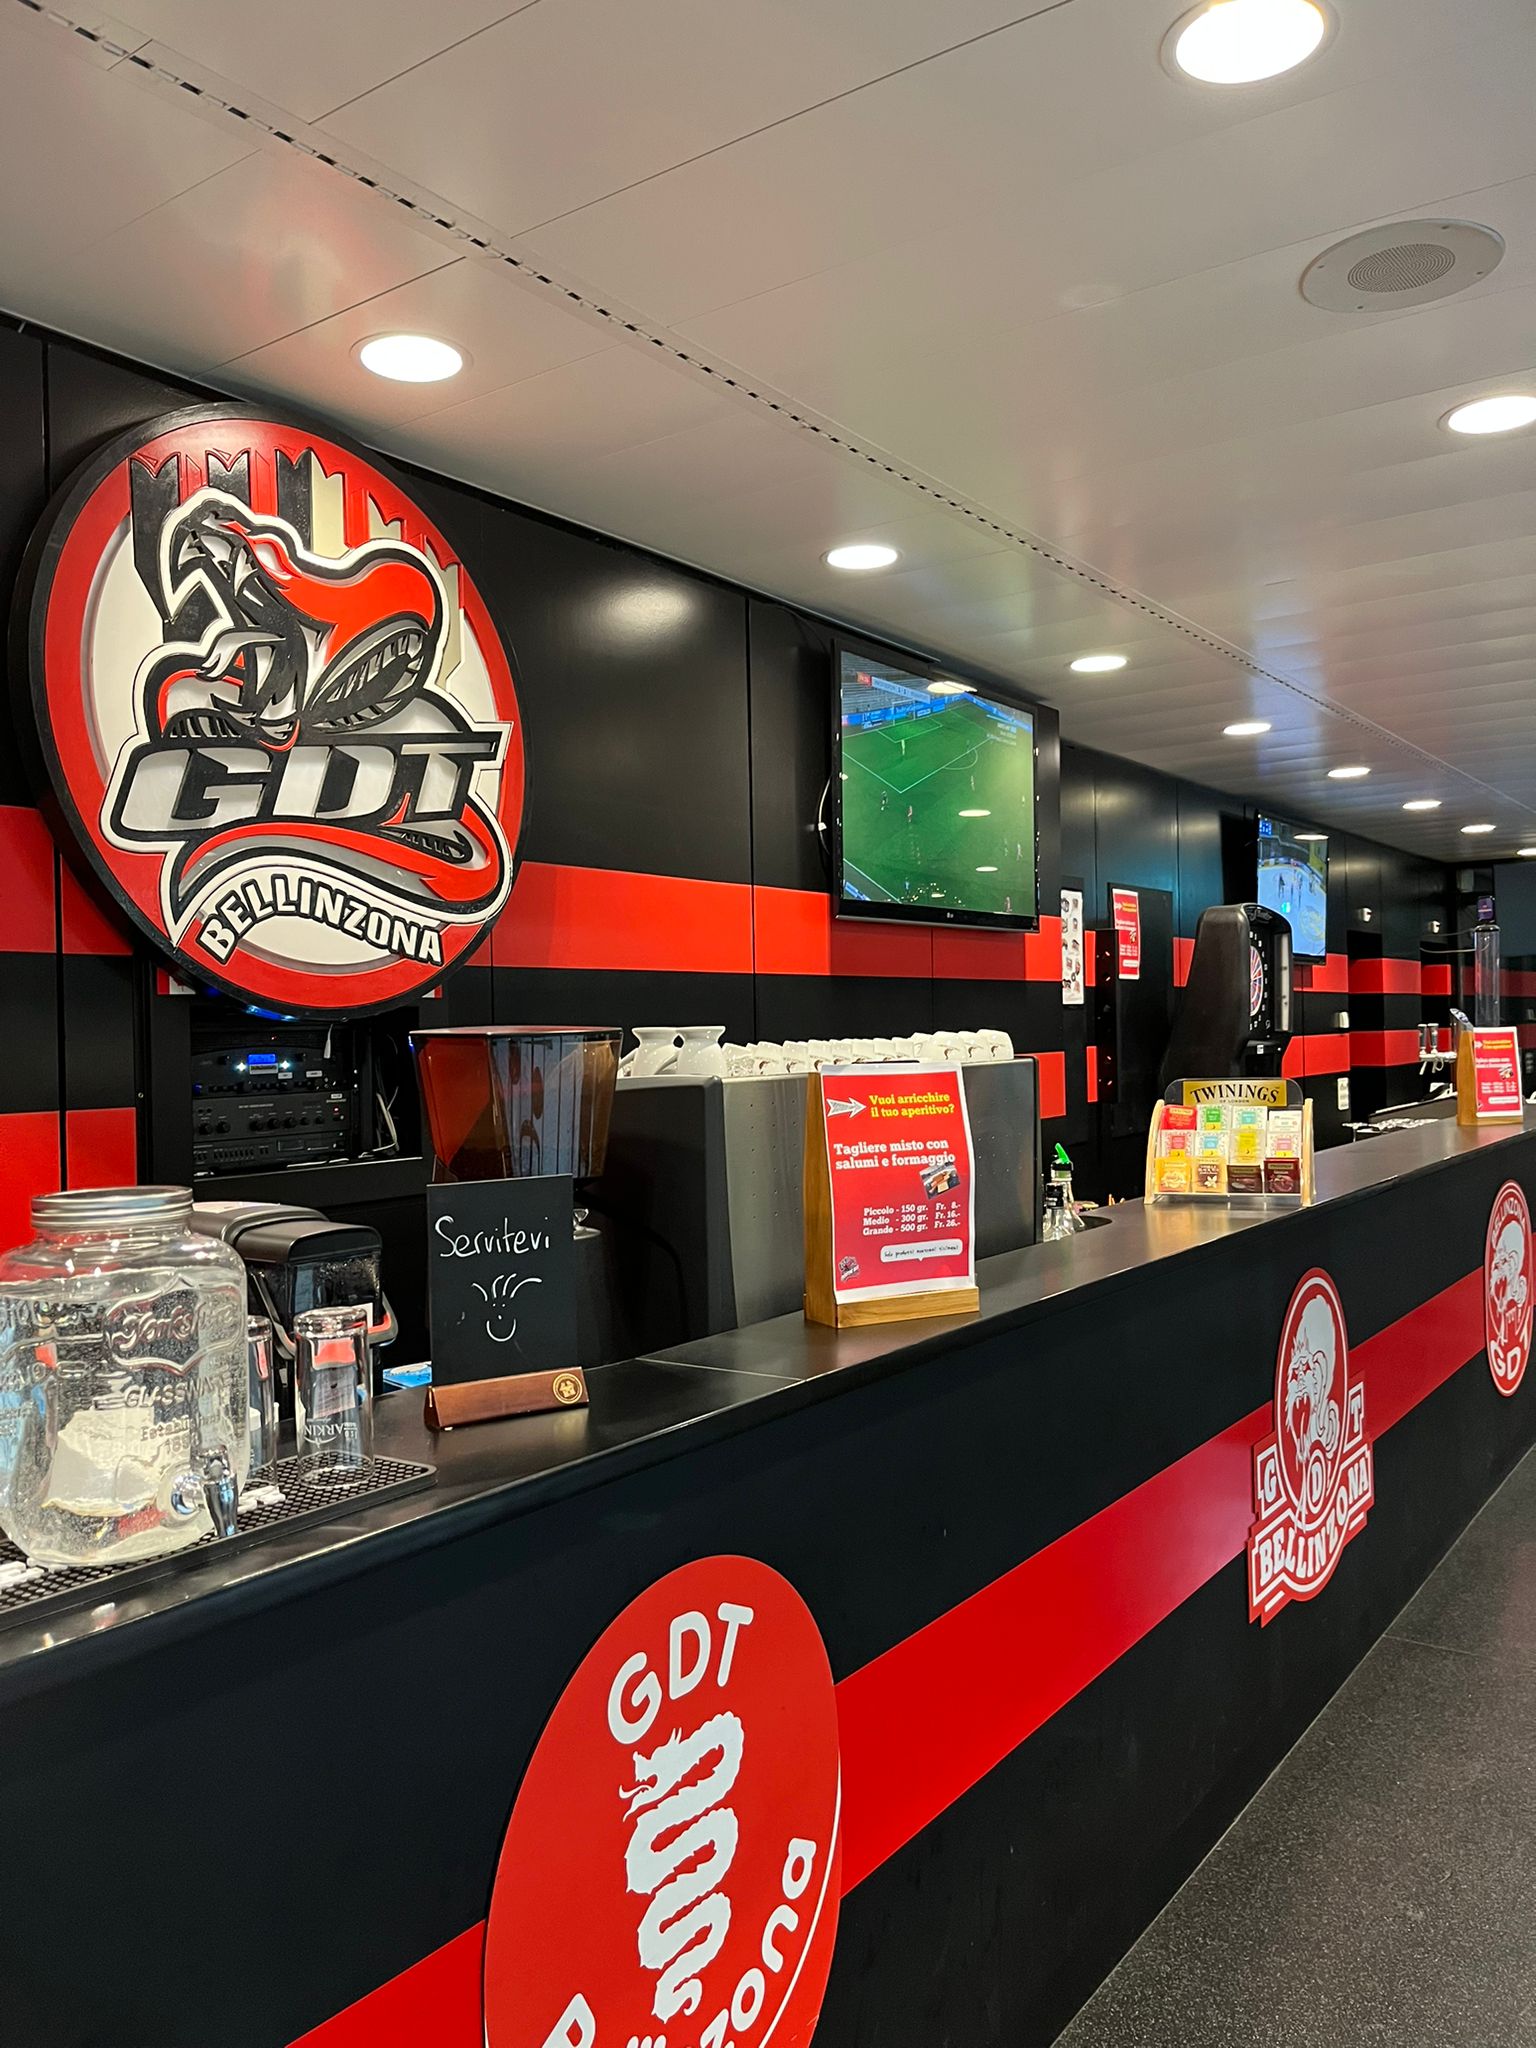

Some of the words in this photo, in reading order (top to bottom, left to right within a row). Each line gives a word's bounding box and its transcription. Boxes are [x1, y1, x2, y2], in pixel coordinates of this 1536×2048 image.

[120, 742, 495, 832] GDT
[198, 876, 444, 963] BELLINZONA
[869, 1094, 895, 1105] Vuoi
[897, 1092, 950, 1104] arricchire
[1190, 1083, 1279, 1103] TWININGS
[871, 1107, 879, 1117] il
[881, 1108, 899, 1117] tuo
[901, 1103, 955, 1118] aperitivo?
[833, 1141, 887, 1157] Tagliere
[889, 1139, 924, 1152] misto
[926, 1139, 949, 1150] con
[835, 1156, 880, 1170] salumi
[881, 1158, 890, 1167] e
[891, 1151, 956, 1167] formaggio
[863, 1205, 894, 1216] Piccolo
[901, 1204, 915, 1213] 150
[935, 1202, 946, 1211] Fr.
[862, 1225, 894, 1236] Grande
[900, 1223, 915, 1233] 500
[934, 1221, 945, 1229] Fr.
[863, 1215, 890, 1226] Medio
[900, 1213, 915, 1223] 300
[935, 1212, 946, 1220] Fr.
[435, 1215, 550, 1258] Servitevi
[1259, 1456, 1369, 1587] BELLINZONA
[608, 1602, 754, 1745] GDT
